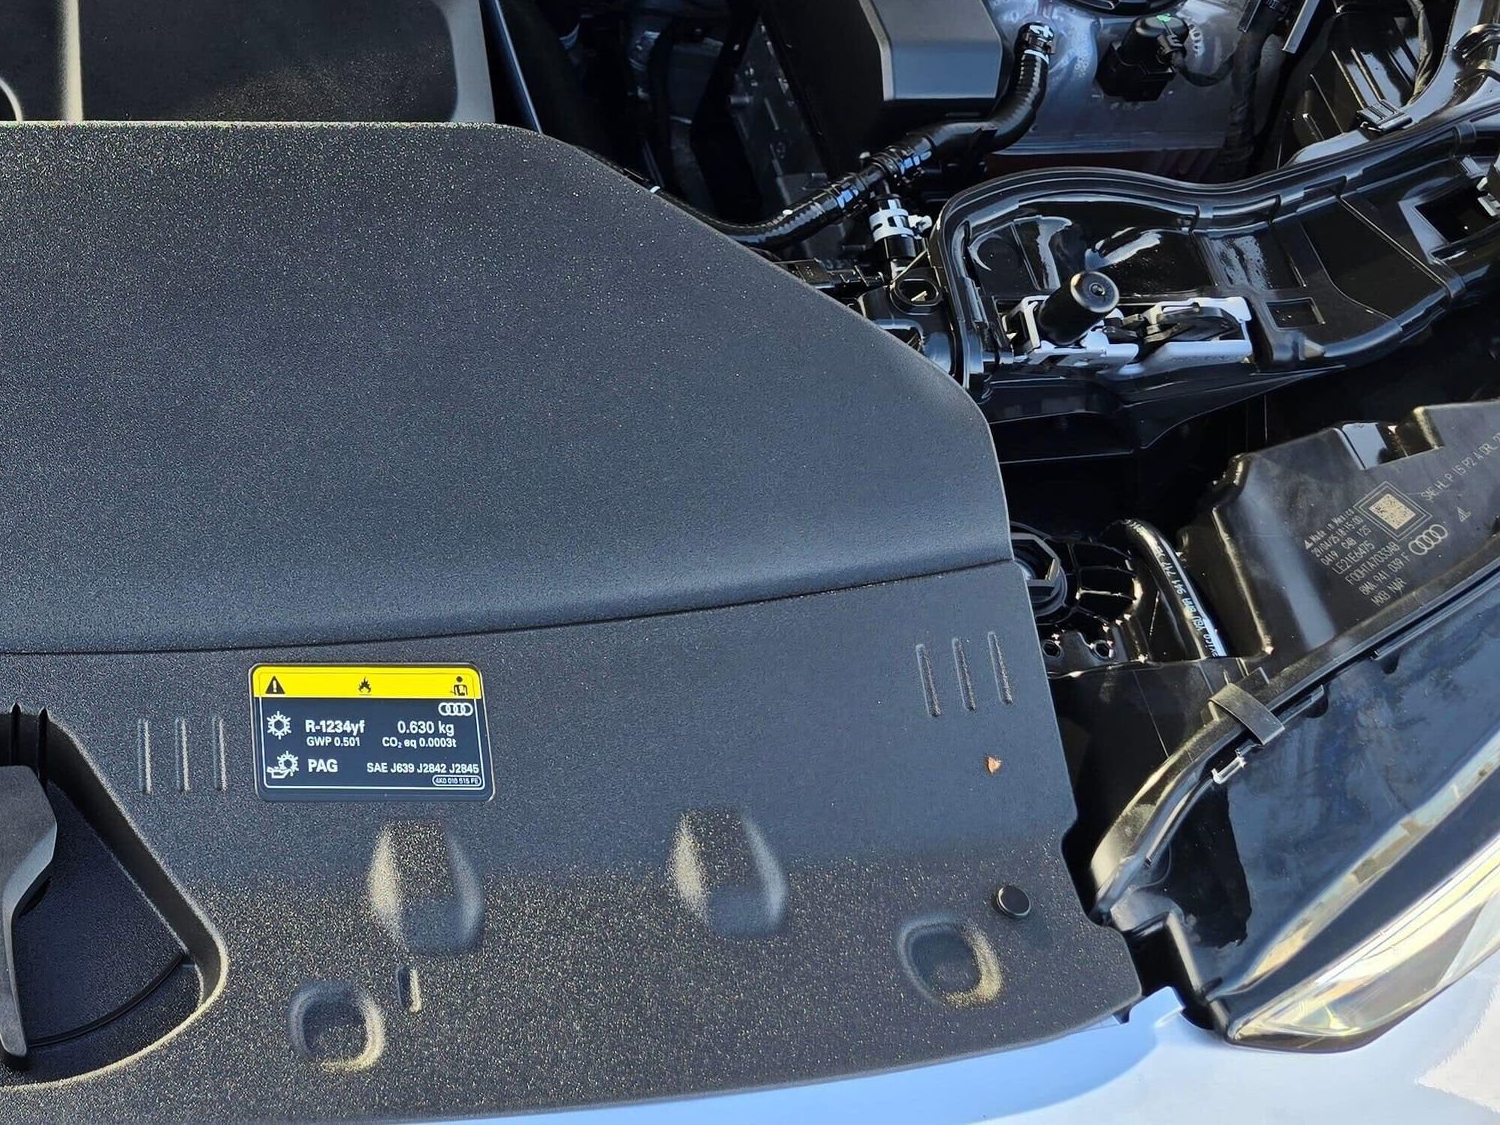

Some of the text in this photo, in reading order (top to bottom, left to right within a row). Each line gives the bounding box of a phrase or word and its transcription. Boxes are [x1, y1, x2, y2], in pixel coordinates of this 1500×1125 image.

[1308, 507, 1356, 543] Made in Mexico
[305, 719, 365, 736] R-1234yf
[397, 720, 455, 736] 0.630 kg
[306, 736, 361, 747] GWP 0.501
[404, 739, 417, 750] eq
[419, 737, 457, 748] 0.0003t
[308, 759, 338, 773] PAG
[366, 763, 480, 774] SAE J639 J2842 J2845
